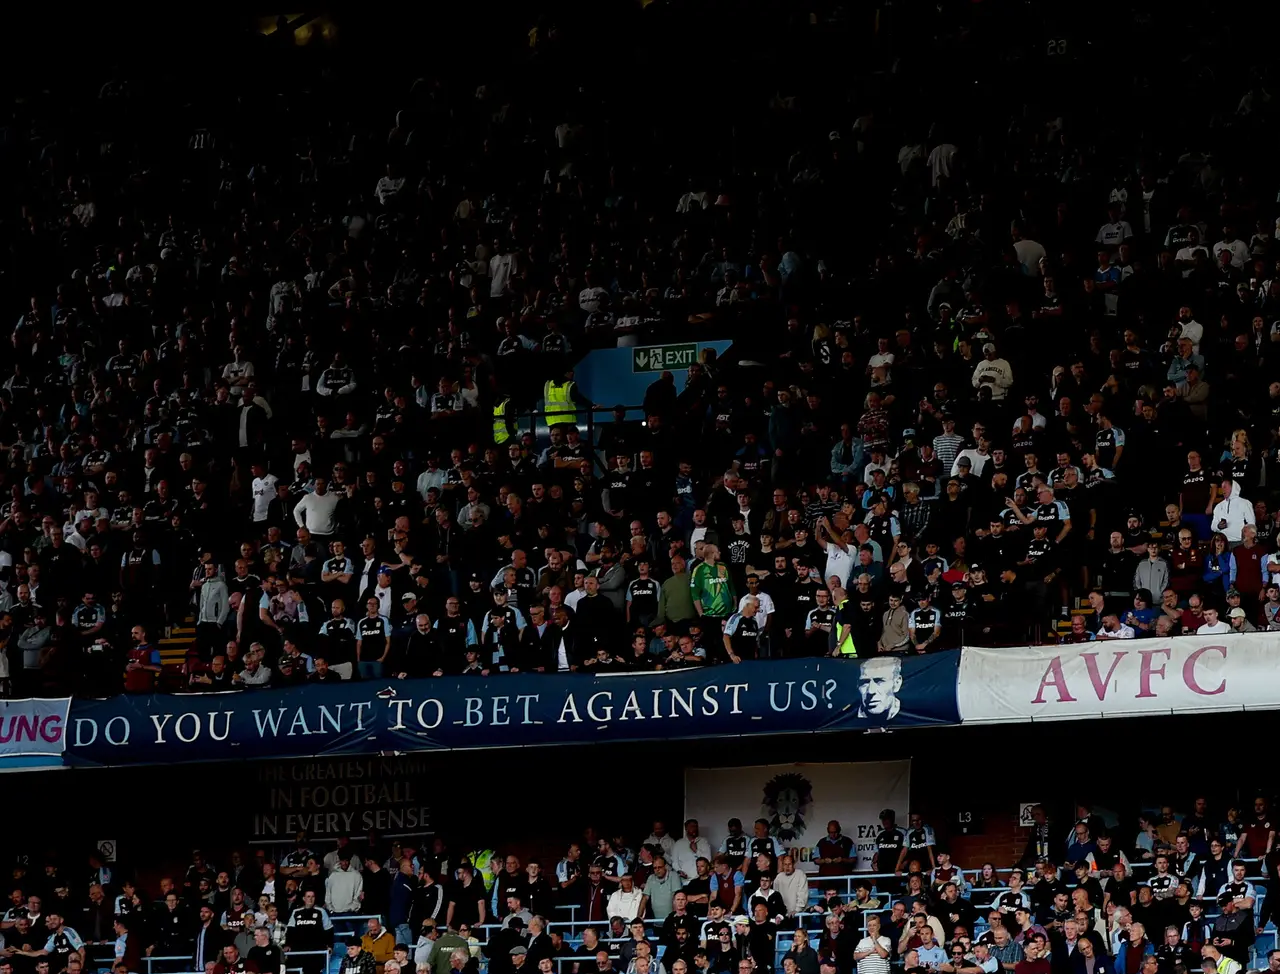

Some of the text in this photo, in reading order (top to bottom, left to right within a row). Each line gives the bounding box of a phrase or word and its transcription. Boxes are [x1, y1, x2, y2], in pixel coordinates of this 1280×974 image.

[665, 349, 694, 365] EXIT
[1030, 643, 1228, 705] AVFC
[74, 678, 837, 746] DO YOU WANT TO BET AGAINST US?
[269, 781, 415, 810] IN FOOTBALL
[253, 805, 432, 835] IN EVERY SENSE
[958, 811, 972, 823] L3
